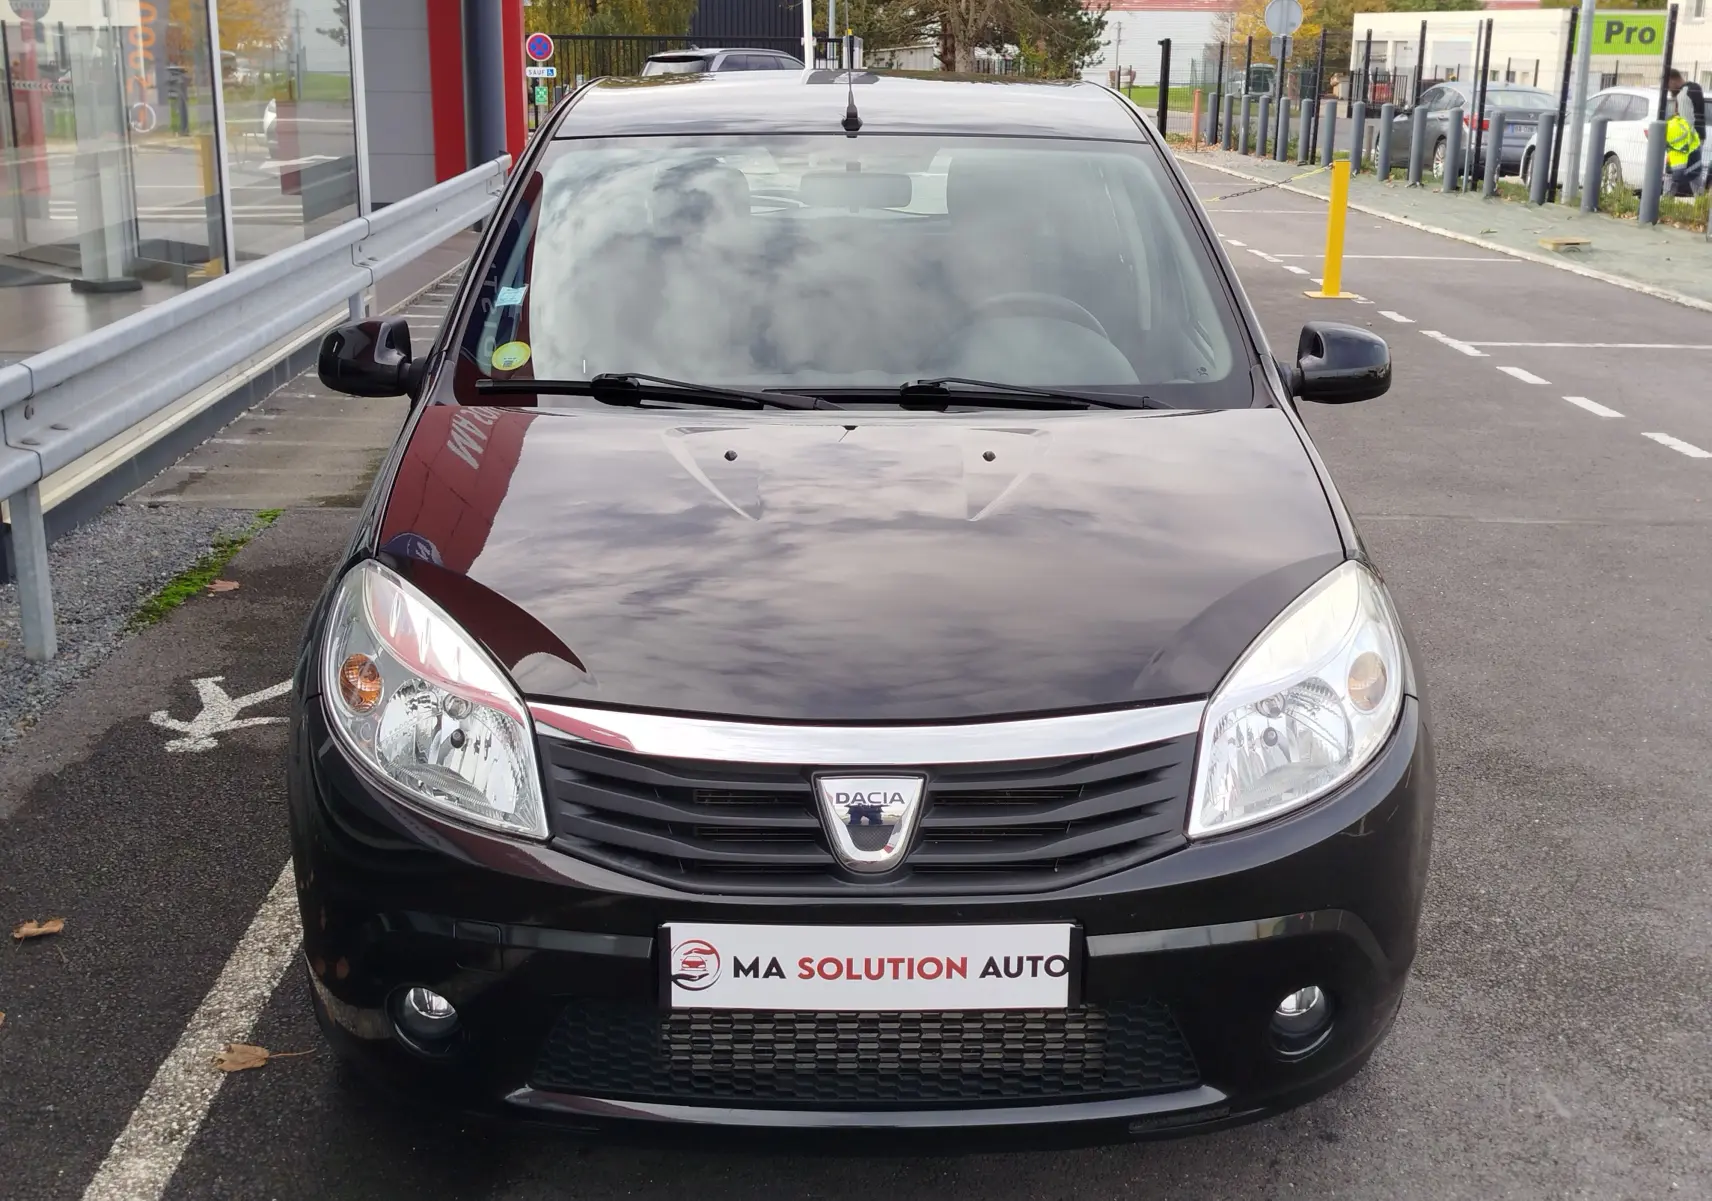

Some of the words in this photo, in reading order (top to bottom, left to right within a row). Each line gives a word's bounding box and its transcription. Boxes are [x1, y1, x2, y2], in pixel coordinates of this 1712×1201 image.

[1604, 20, 1656, 44] Pro
[835, 791, 905, 805] DACIA
[733, 956, 786, 979] MA
[798, 956, 967, 980] SOLUTION
[979, 954, 1069, 978] AUTO
